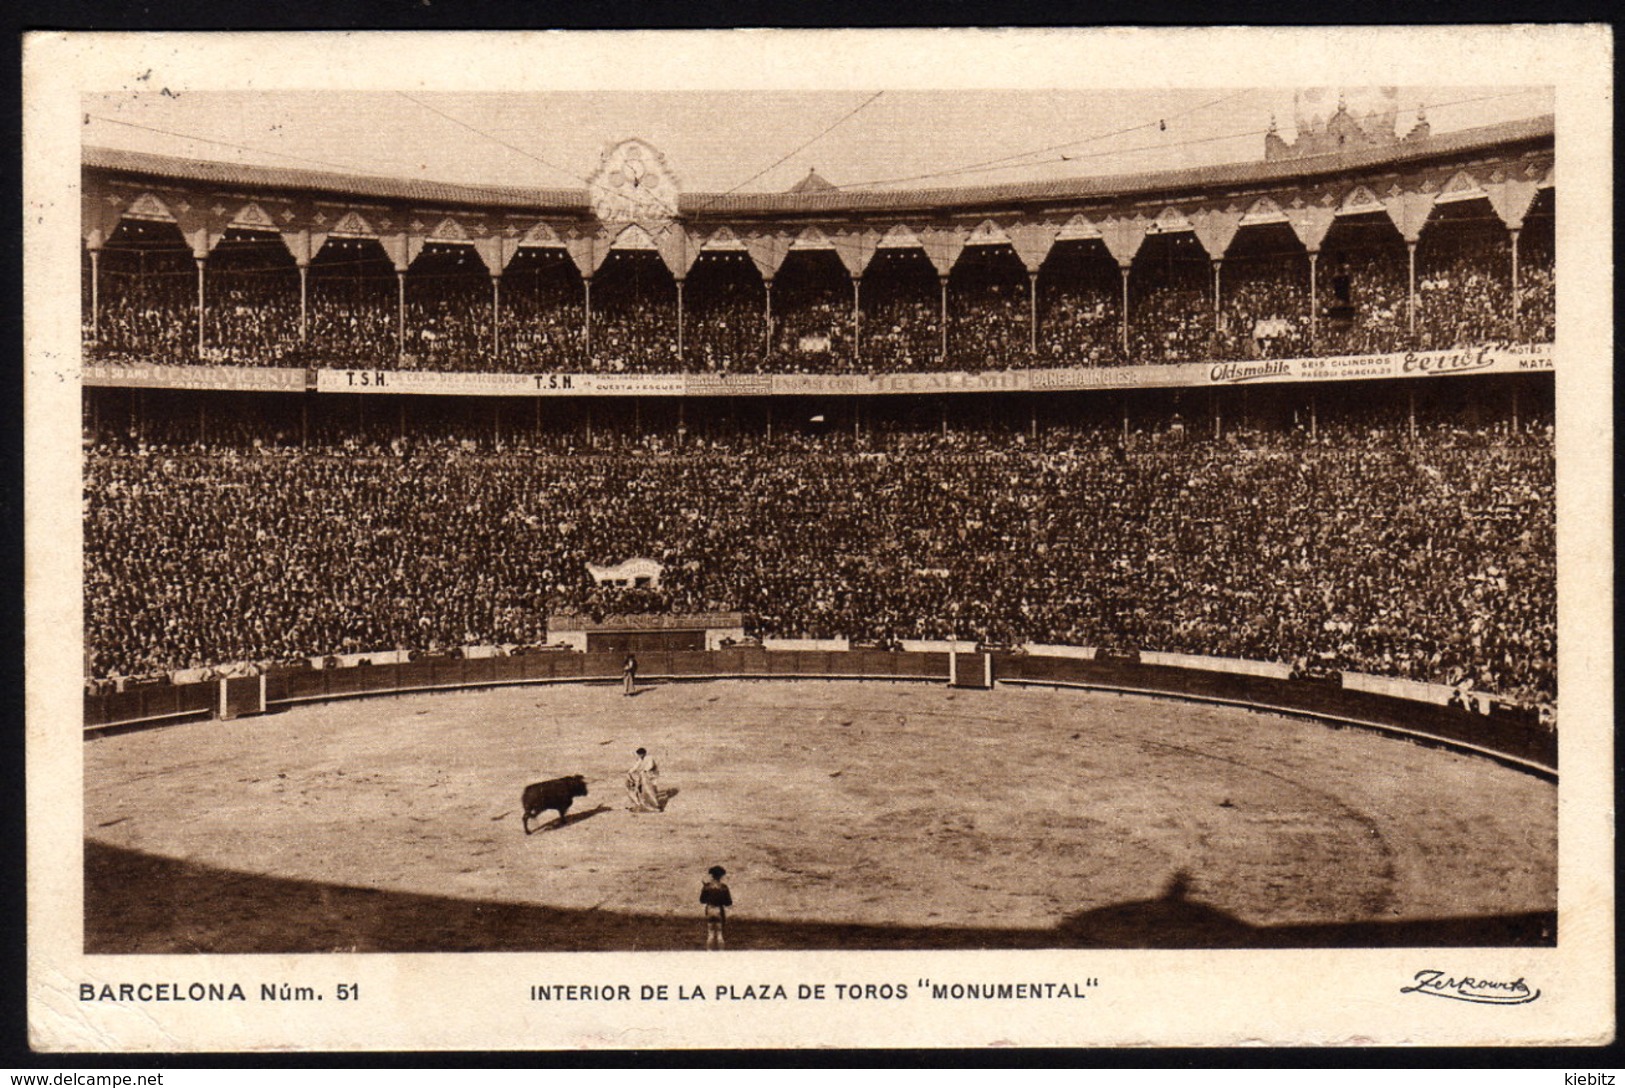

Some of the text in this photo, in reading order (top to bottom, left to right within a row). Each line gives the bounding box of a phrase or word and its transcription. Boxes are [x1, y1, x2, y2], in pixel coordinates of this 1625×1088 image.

[1210, 360, 1292, 382] Oldsmobile
[1301, 357, 1391, 369] SEIS CILINDROS
[1518, 358, 1554, 369] MATA
[346, 371, 389, 387] T.S.H.
[534, 375, 575, 390] T.S.H.
[79, 983, 359, 1001] BARCELONA Núm. 51
[531, 985, 631, 1001] INTERIOR
[640, 985, 669, 1001] DE
[679, 985, 706, 1000] LA
[715, 985, 788, 1000] PLAZA
[798, 984, 825, 1000] DE
[834, 984, 908, 1000] TOROS
